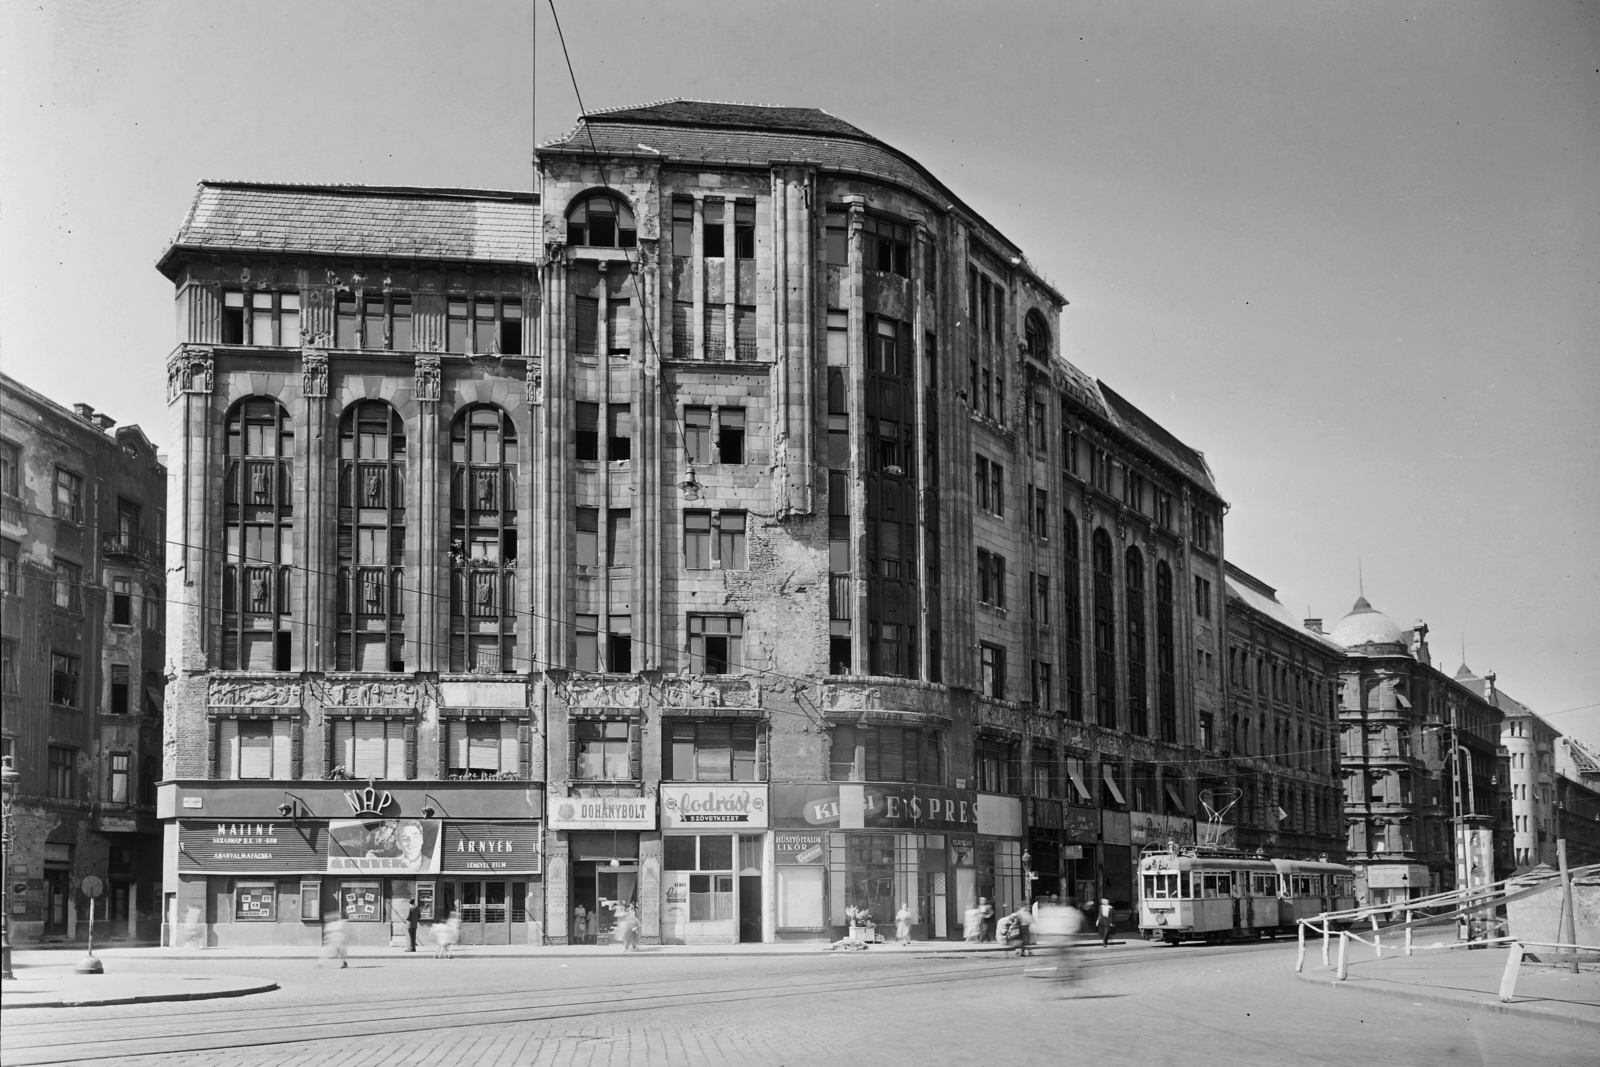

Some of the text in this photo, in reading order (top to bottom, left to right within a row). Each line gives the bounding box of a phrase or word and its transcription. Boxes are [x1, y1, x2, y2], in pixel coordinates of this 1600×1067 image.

[344, 787, 392, 813] NAP
[581, 803, 647, 819] DOHÁNYBOLT
[457, 838, 513, 852] ÁRNYÉK
[801, 836, 822, 844] ITALOK
